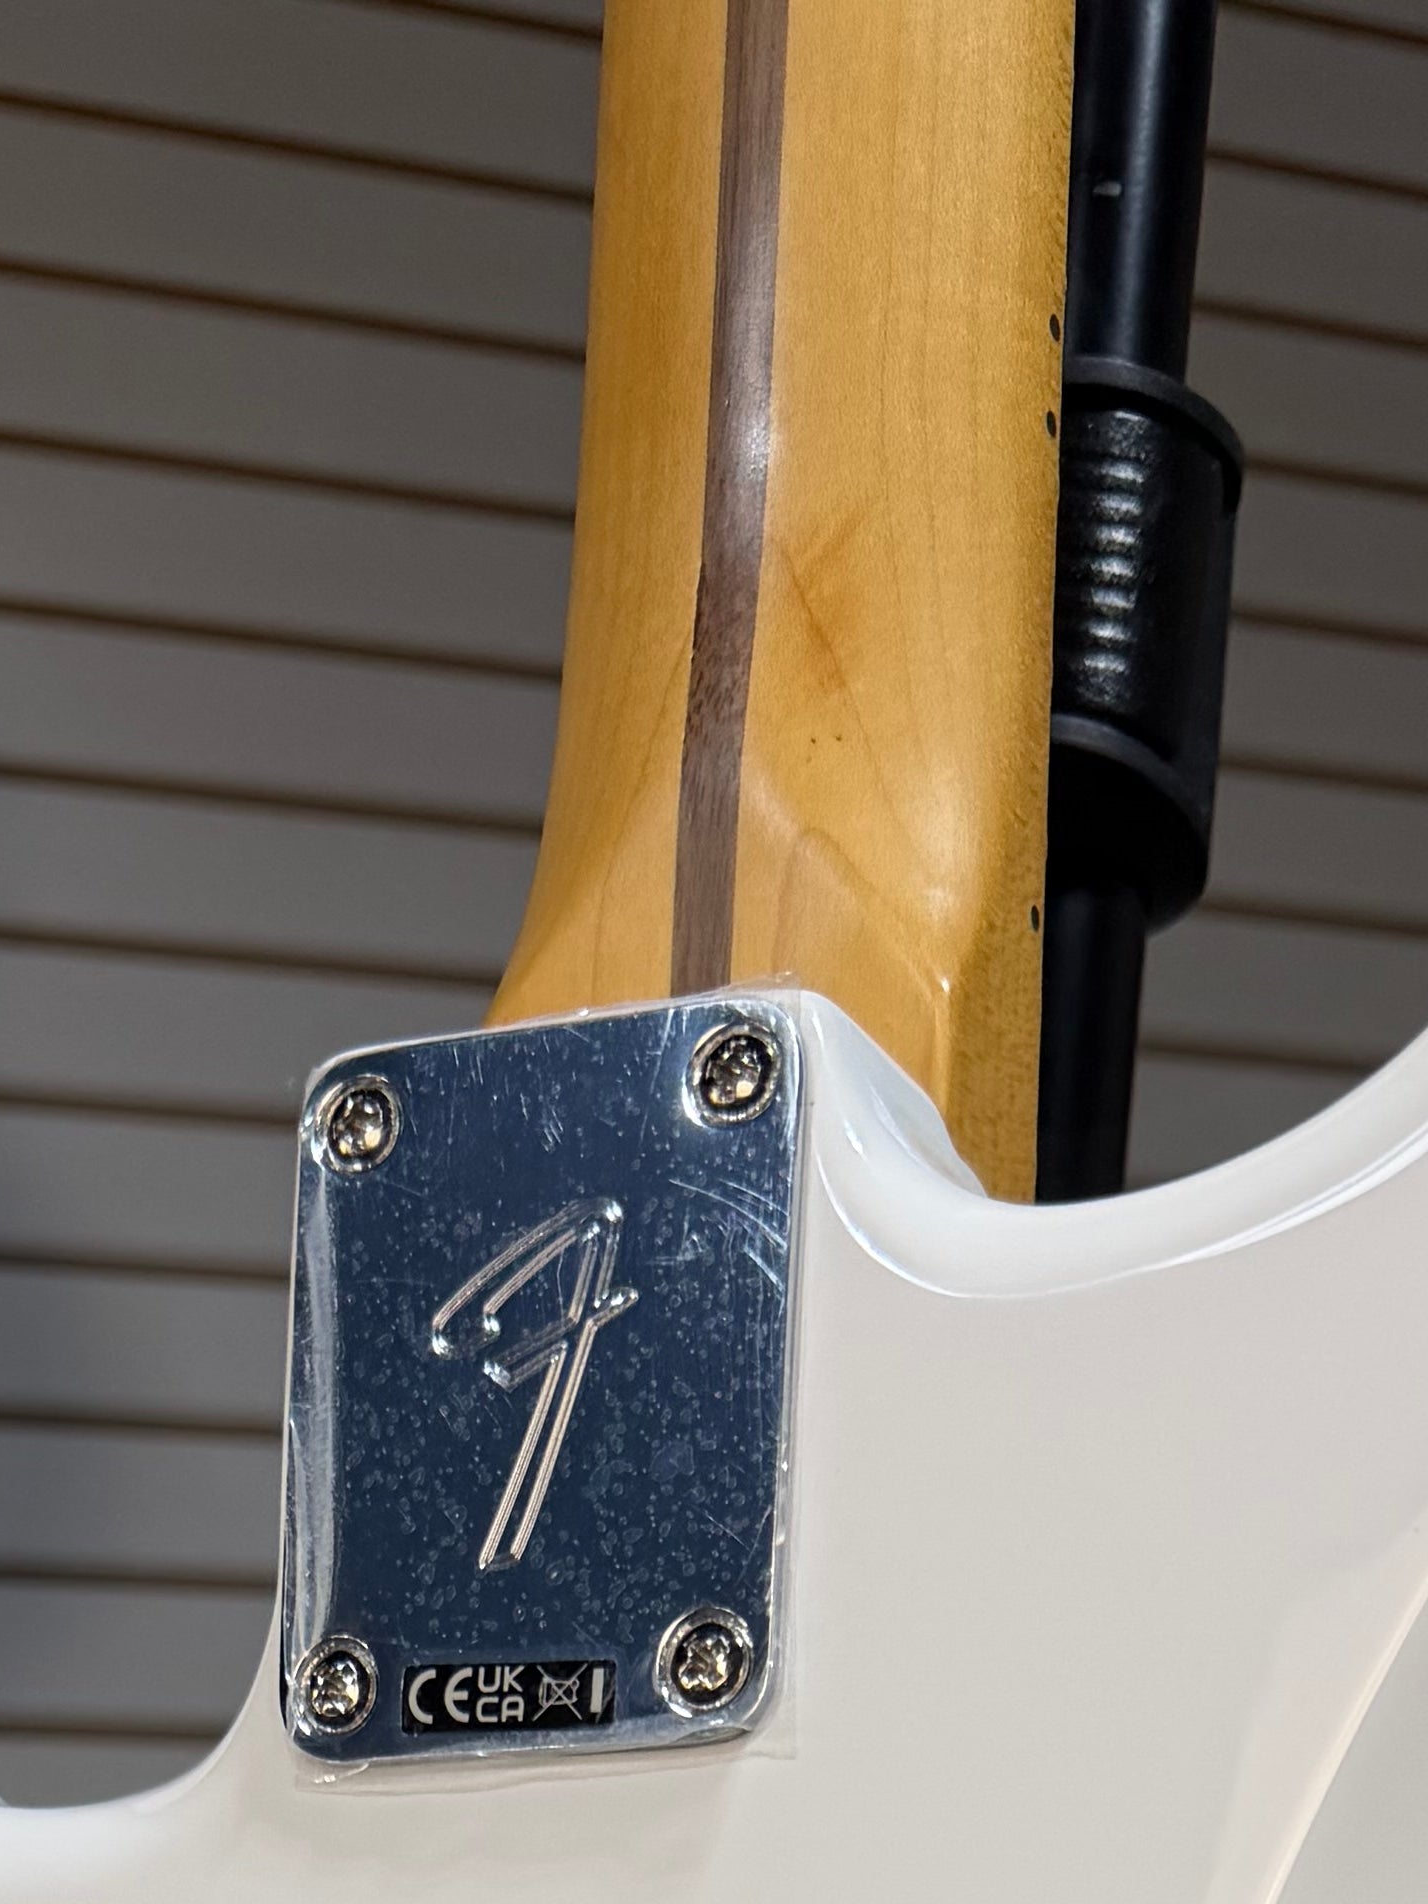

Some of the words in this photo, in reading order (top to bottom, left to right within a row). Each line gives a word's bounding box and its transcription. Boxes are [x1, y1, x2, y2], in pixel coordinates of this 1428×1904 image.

[477, 1665, 526, 1693] UK
[408, 1666, 473, 1725] CE
[475, 1695, 525, 1723] CA
